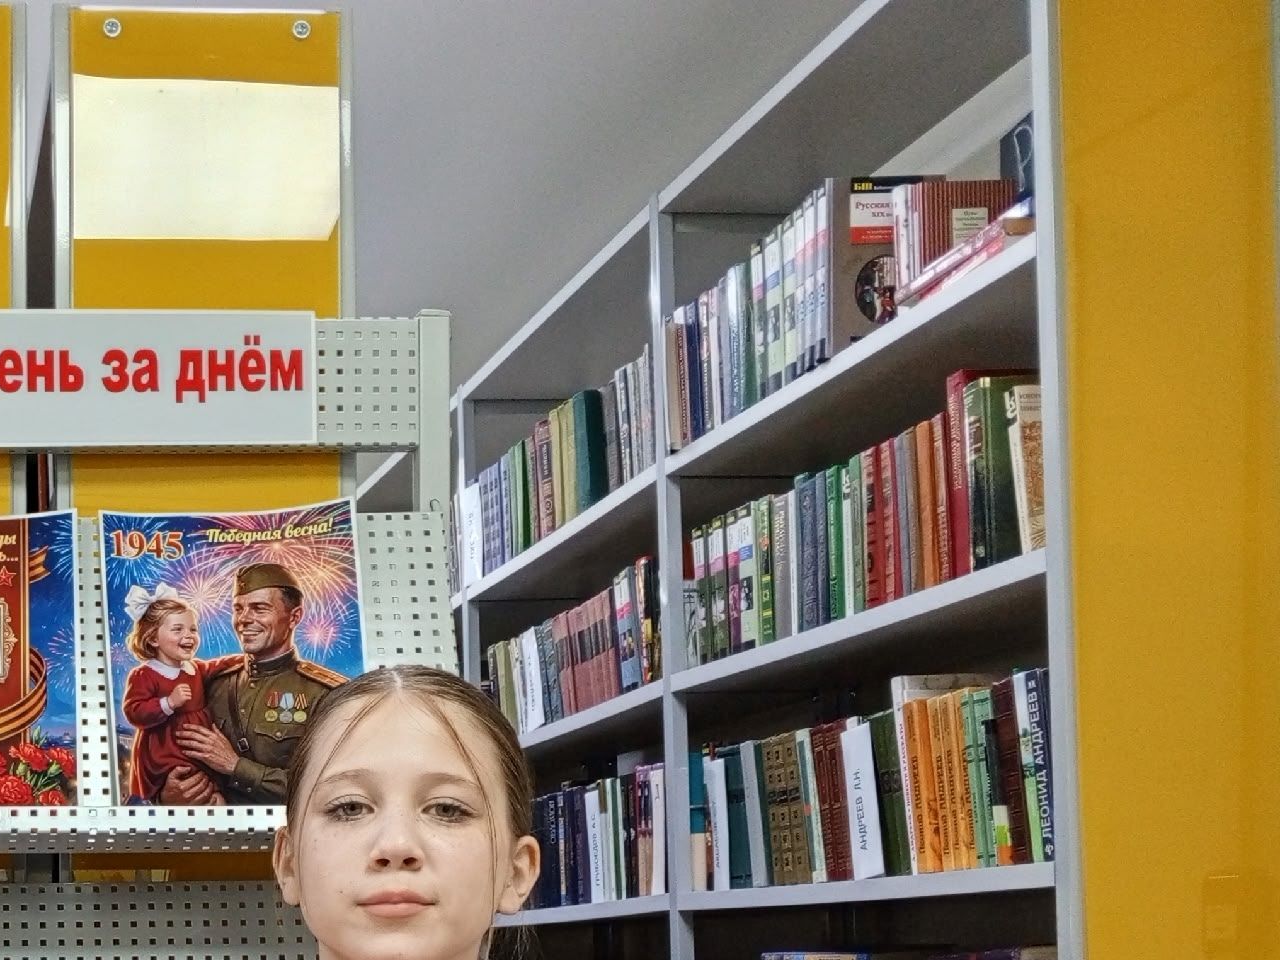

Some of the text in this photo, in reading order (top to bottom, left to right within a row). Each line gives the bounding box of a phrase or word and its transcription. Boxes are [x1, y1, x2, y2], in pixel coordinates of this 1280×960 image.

[102, 348, 160, 393] за
[176, 335, 304, 403] днём
[111, 529, 184, 560] 1945
[206, 518, 333, 545] Победная весна!
[911, 755, 922, 810] АНДРЕЕВ
[935, 755, 947, 810] АНДРЕЕВ
[945, 749, 956, 805] АНДРЕЕВ
[1027, 691, 1052, 839] ЛЕОНИД АНДРЕЕВ
[852, 768, 868, 851] АНДРЕЕВ Л.Н.
